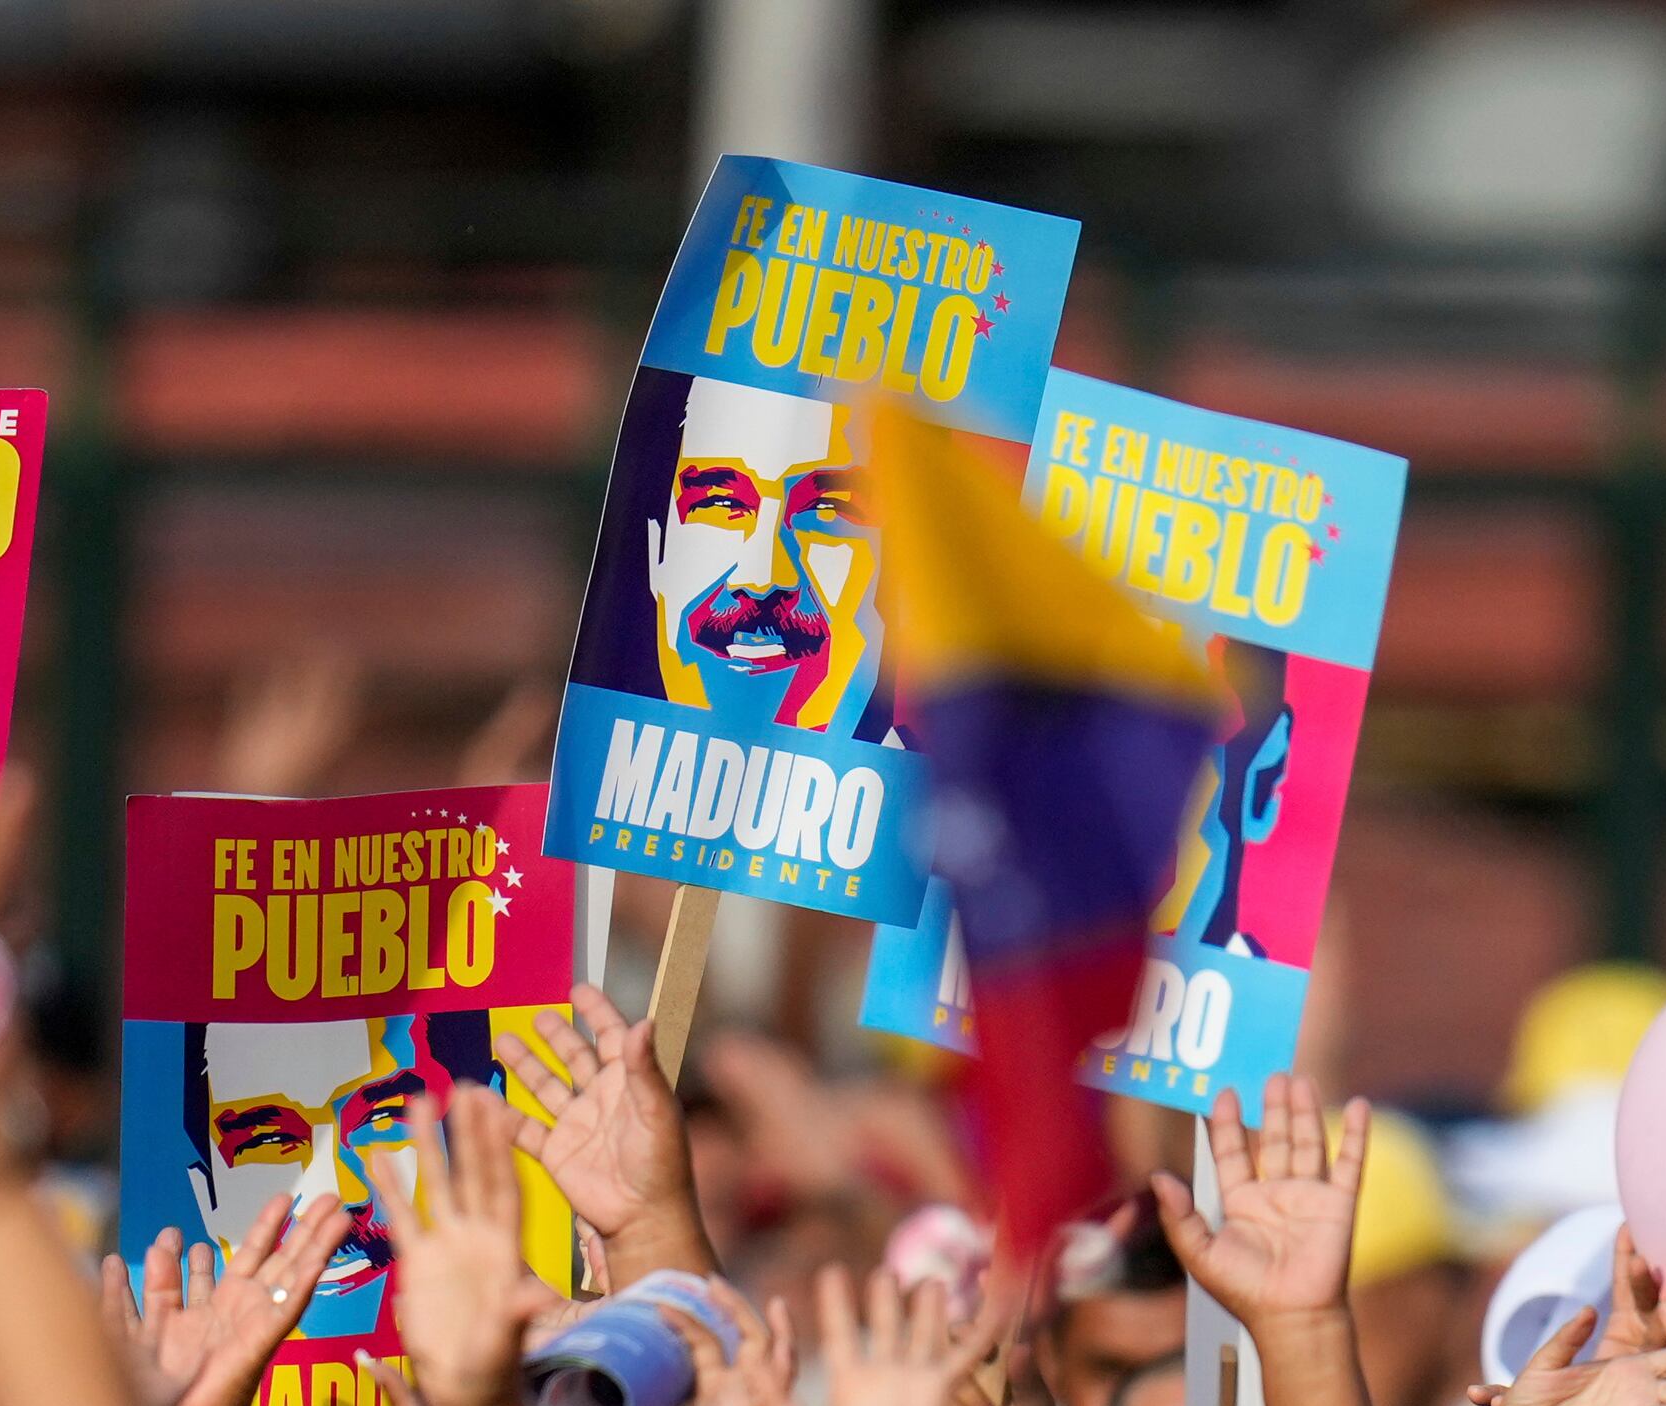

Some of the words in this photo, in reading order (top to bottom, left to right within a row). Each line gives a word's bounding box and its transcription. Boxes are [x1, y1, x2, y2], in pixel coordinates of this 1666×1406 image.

[730, 194, 771, 255] FE
[777, 203, 823, 260] EN
[833, 214, 995, 294] NUESTRO
[704, 249, 981, 402] PUEBLO
[1051, 410, 1096, 467] FE
[1100, 424, 1149, 482] EN
[1154, 439, 1325, 524] NUESTRO
[1039, 463, 1313, 628] PUEBLO
[593, 718, 884, 871] MADURO
[214, 838, 257, 890] FE
[273, 839, 320, 888] EN
[335, 826, 498, 889] NUESTRO
[590, 823, 861, 899] PRESIDENTE
[213, 881, 496, 1001] PUEBLO
